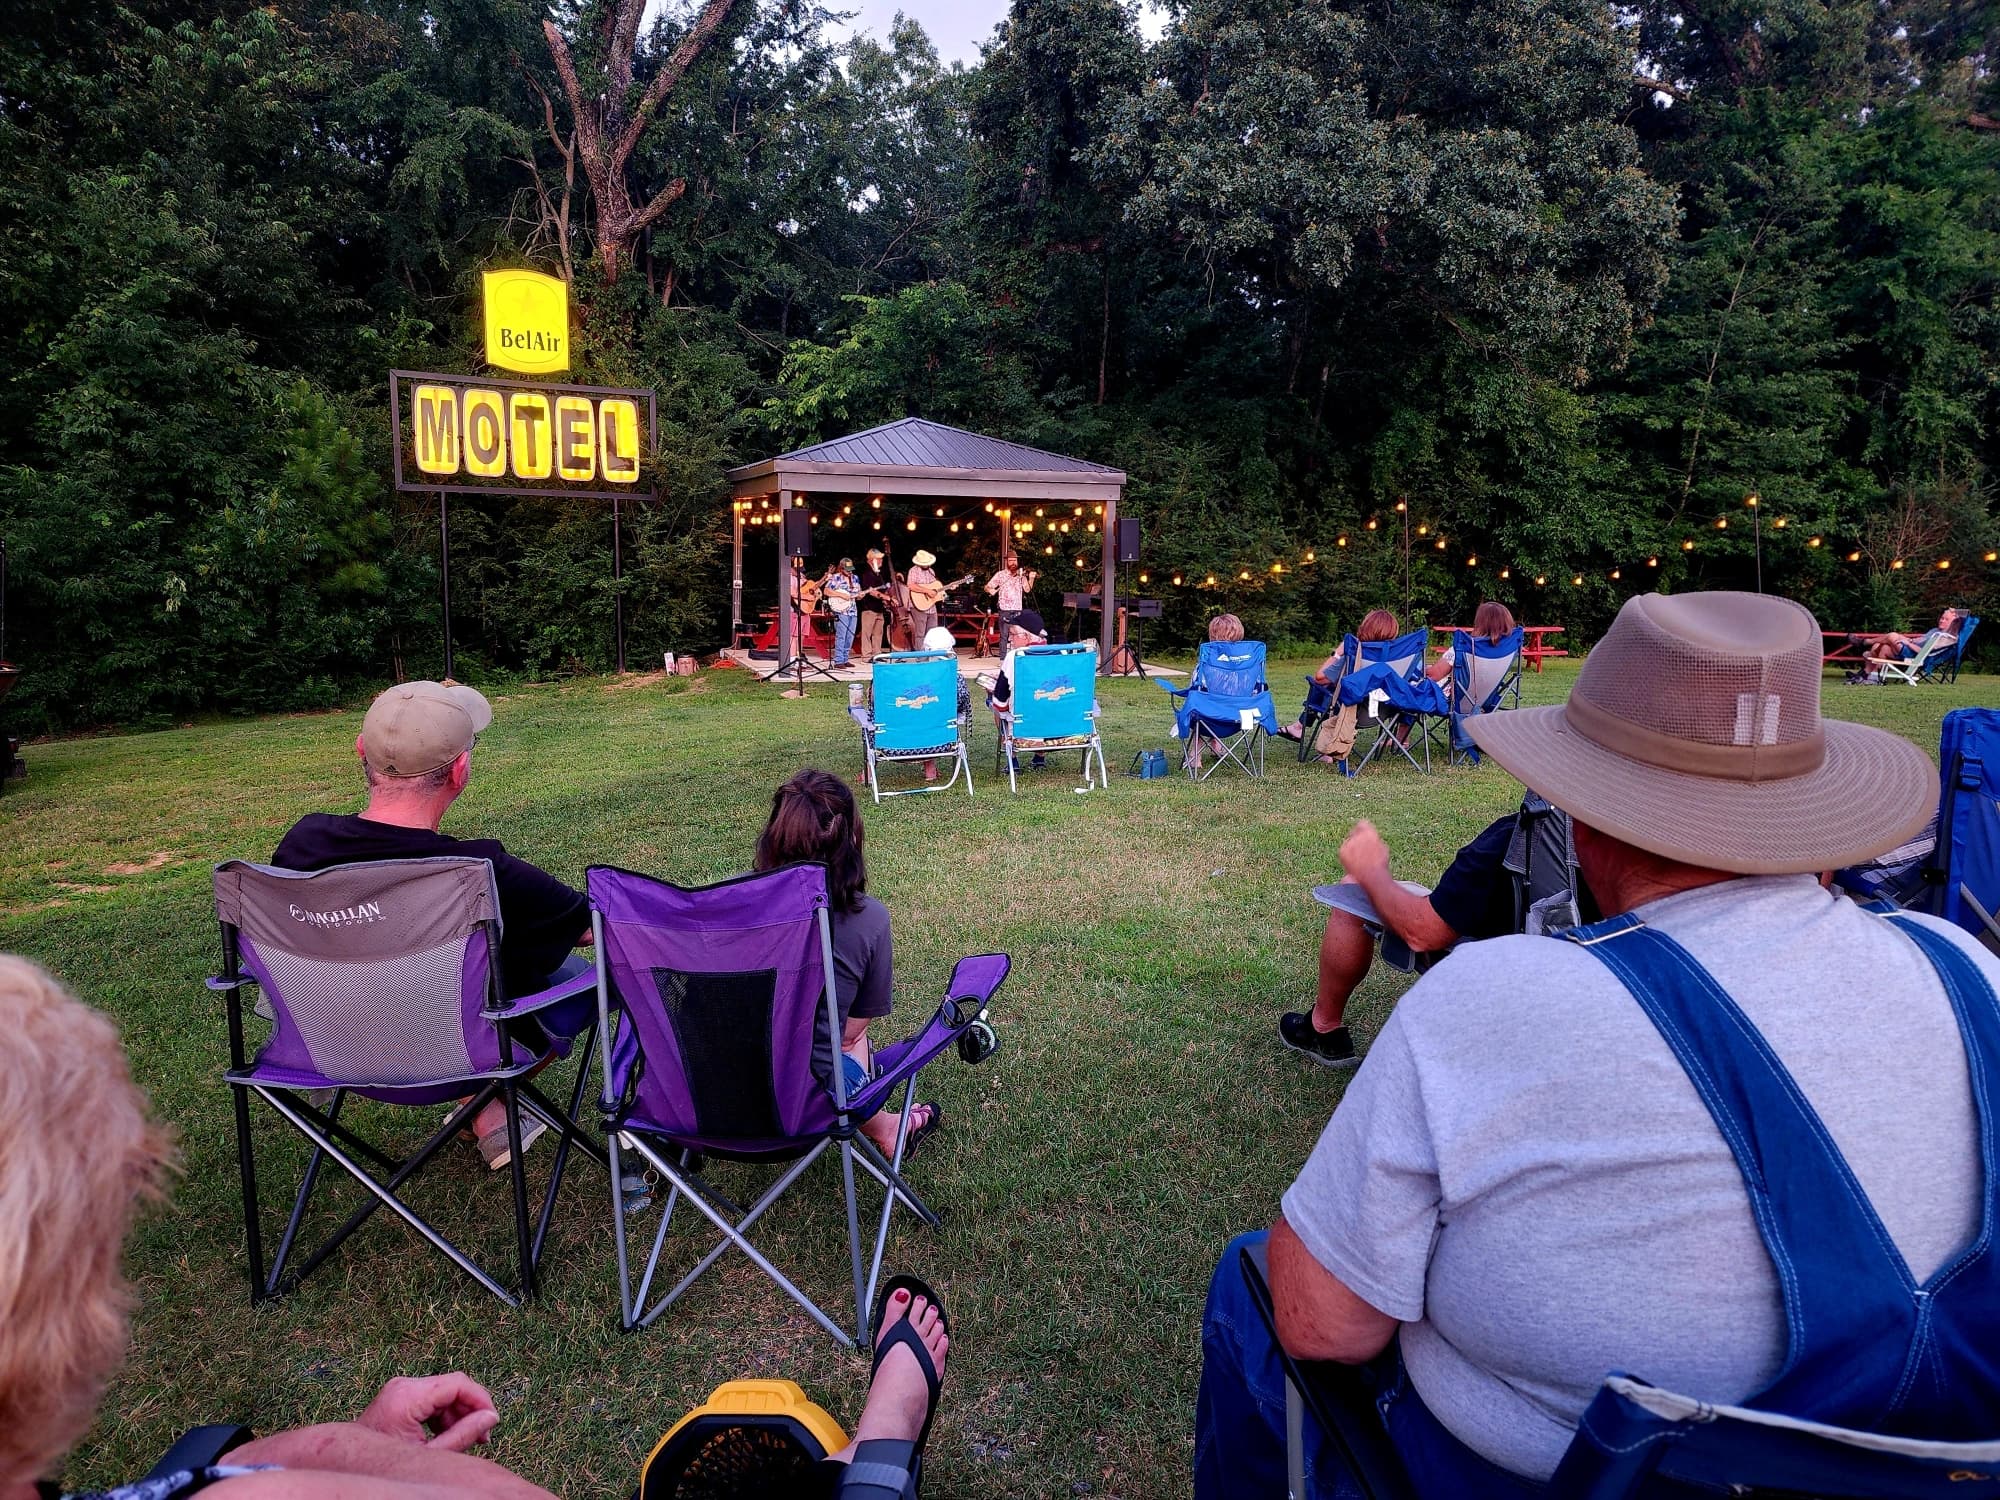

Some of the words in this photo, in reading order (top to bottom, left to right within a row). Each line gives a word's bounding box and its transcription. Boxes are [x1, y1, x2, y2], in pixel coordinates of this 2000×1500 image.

[501, 328, 560, 352] BelAir
[420, 397, 635, 471] MOTEL
[305, 902, 380, 924] MAGELLAN
